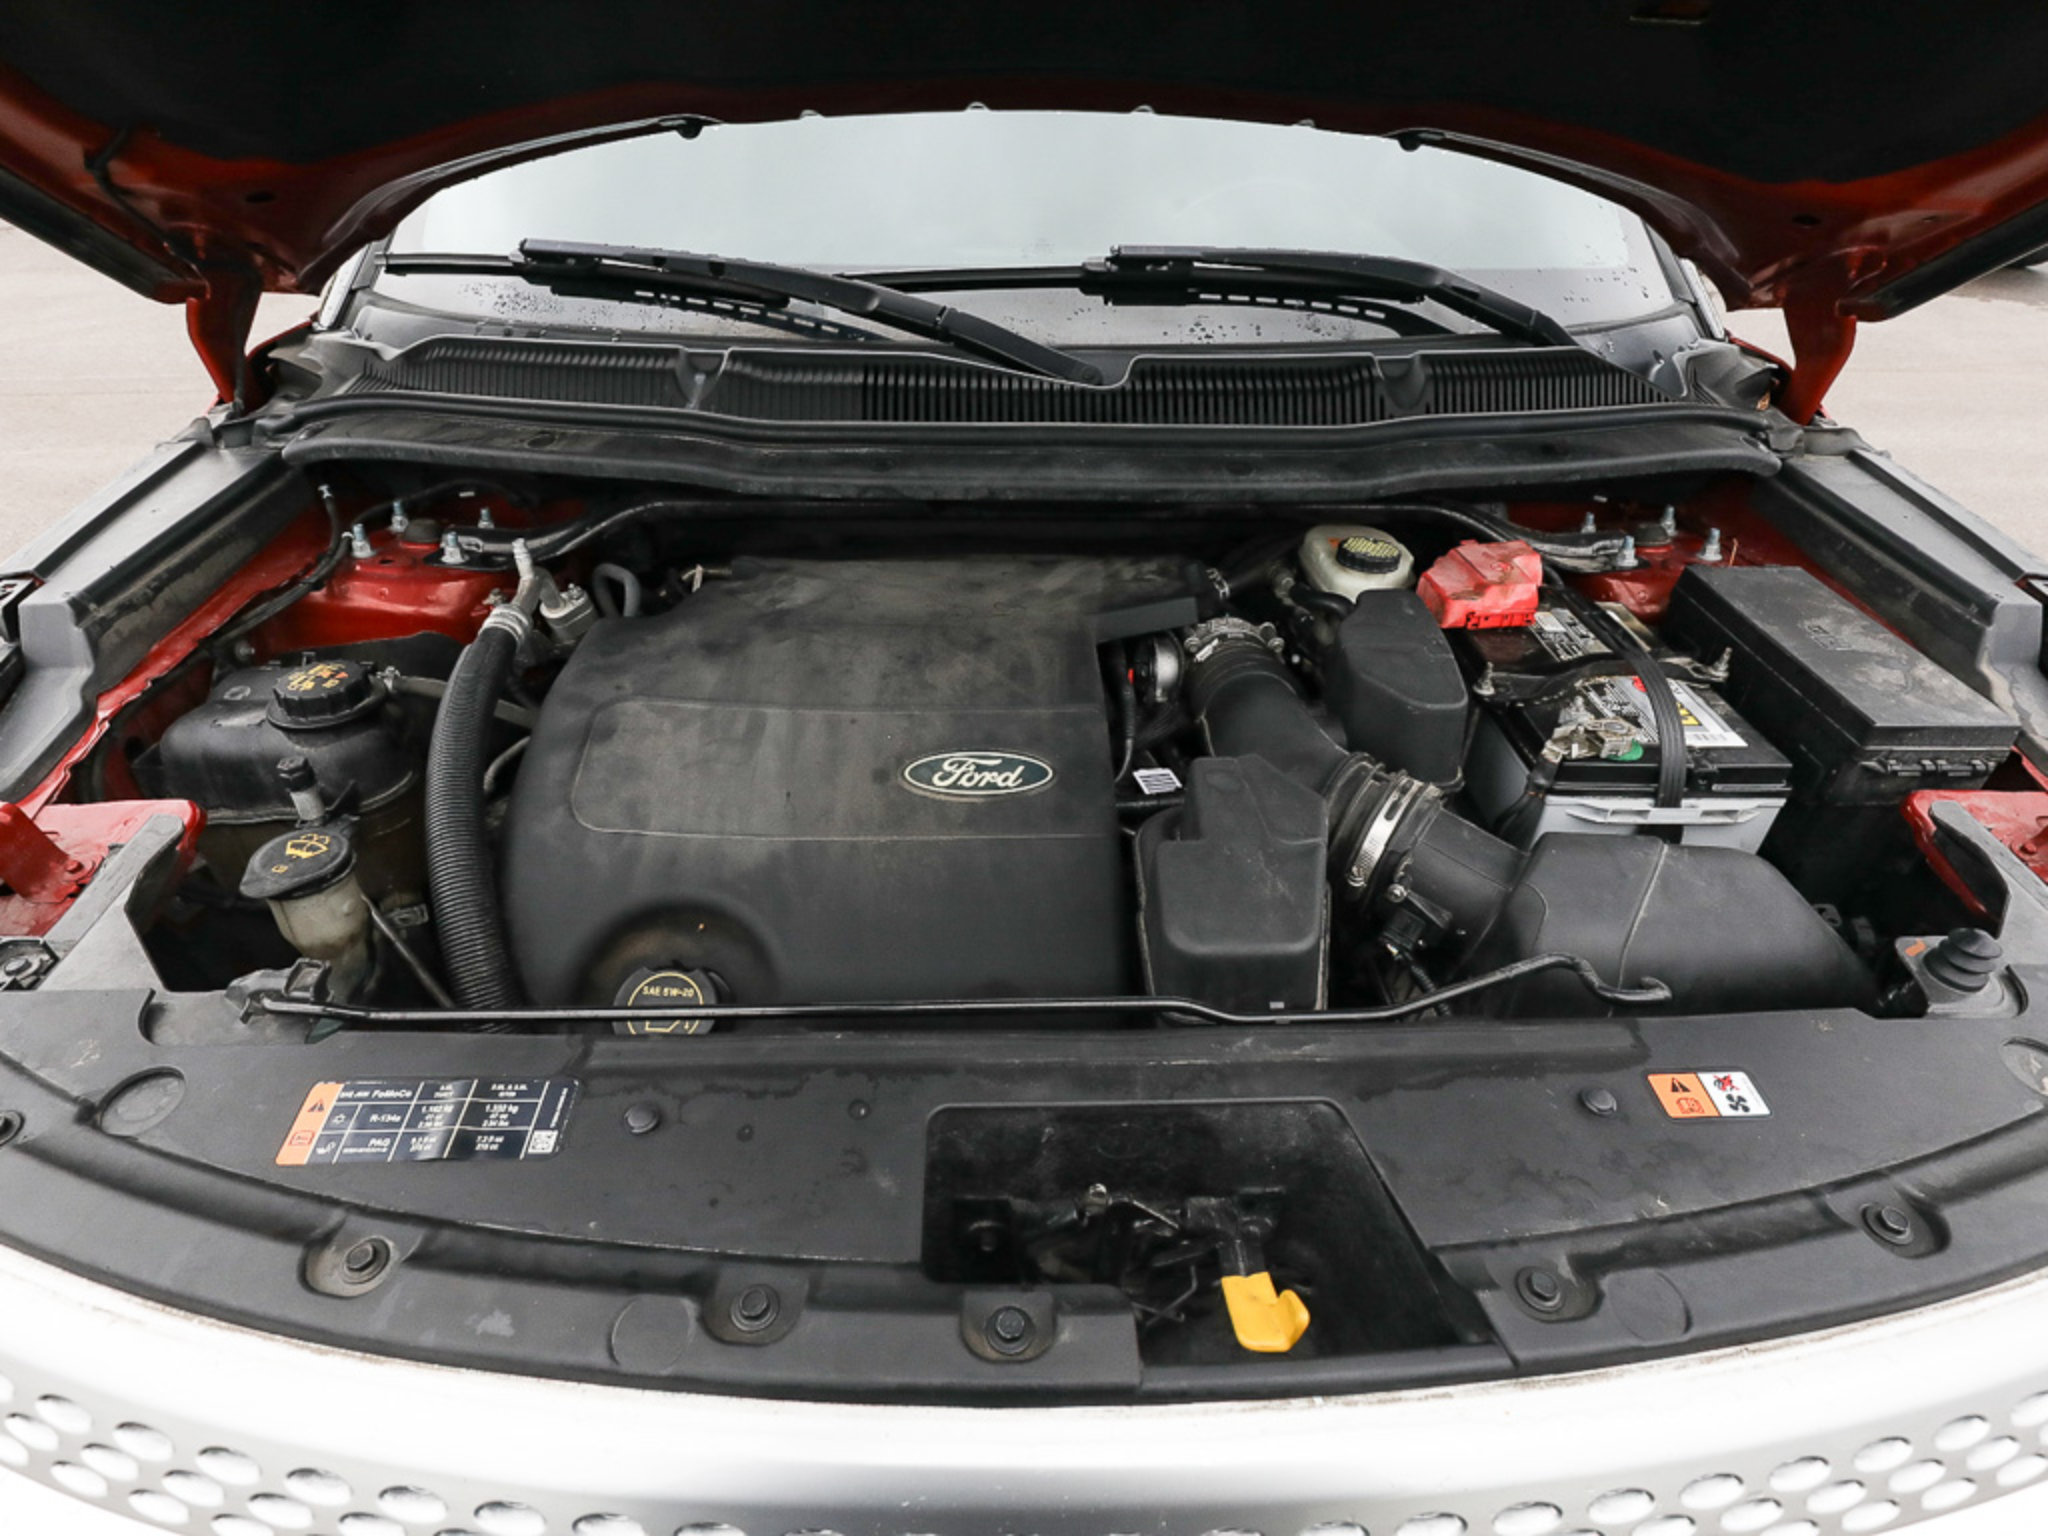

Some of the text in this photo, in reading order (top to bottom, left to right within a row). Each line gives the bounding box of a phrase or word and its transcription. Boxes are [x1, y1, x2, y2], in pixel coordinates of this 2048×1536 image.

[932, 757, 1025, 787] Ford
[642, 985, 695, 997] SAE 5W-20
